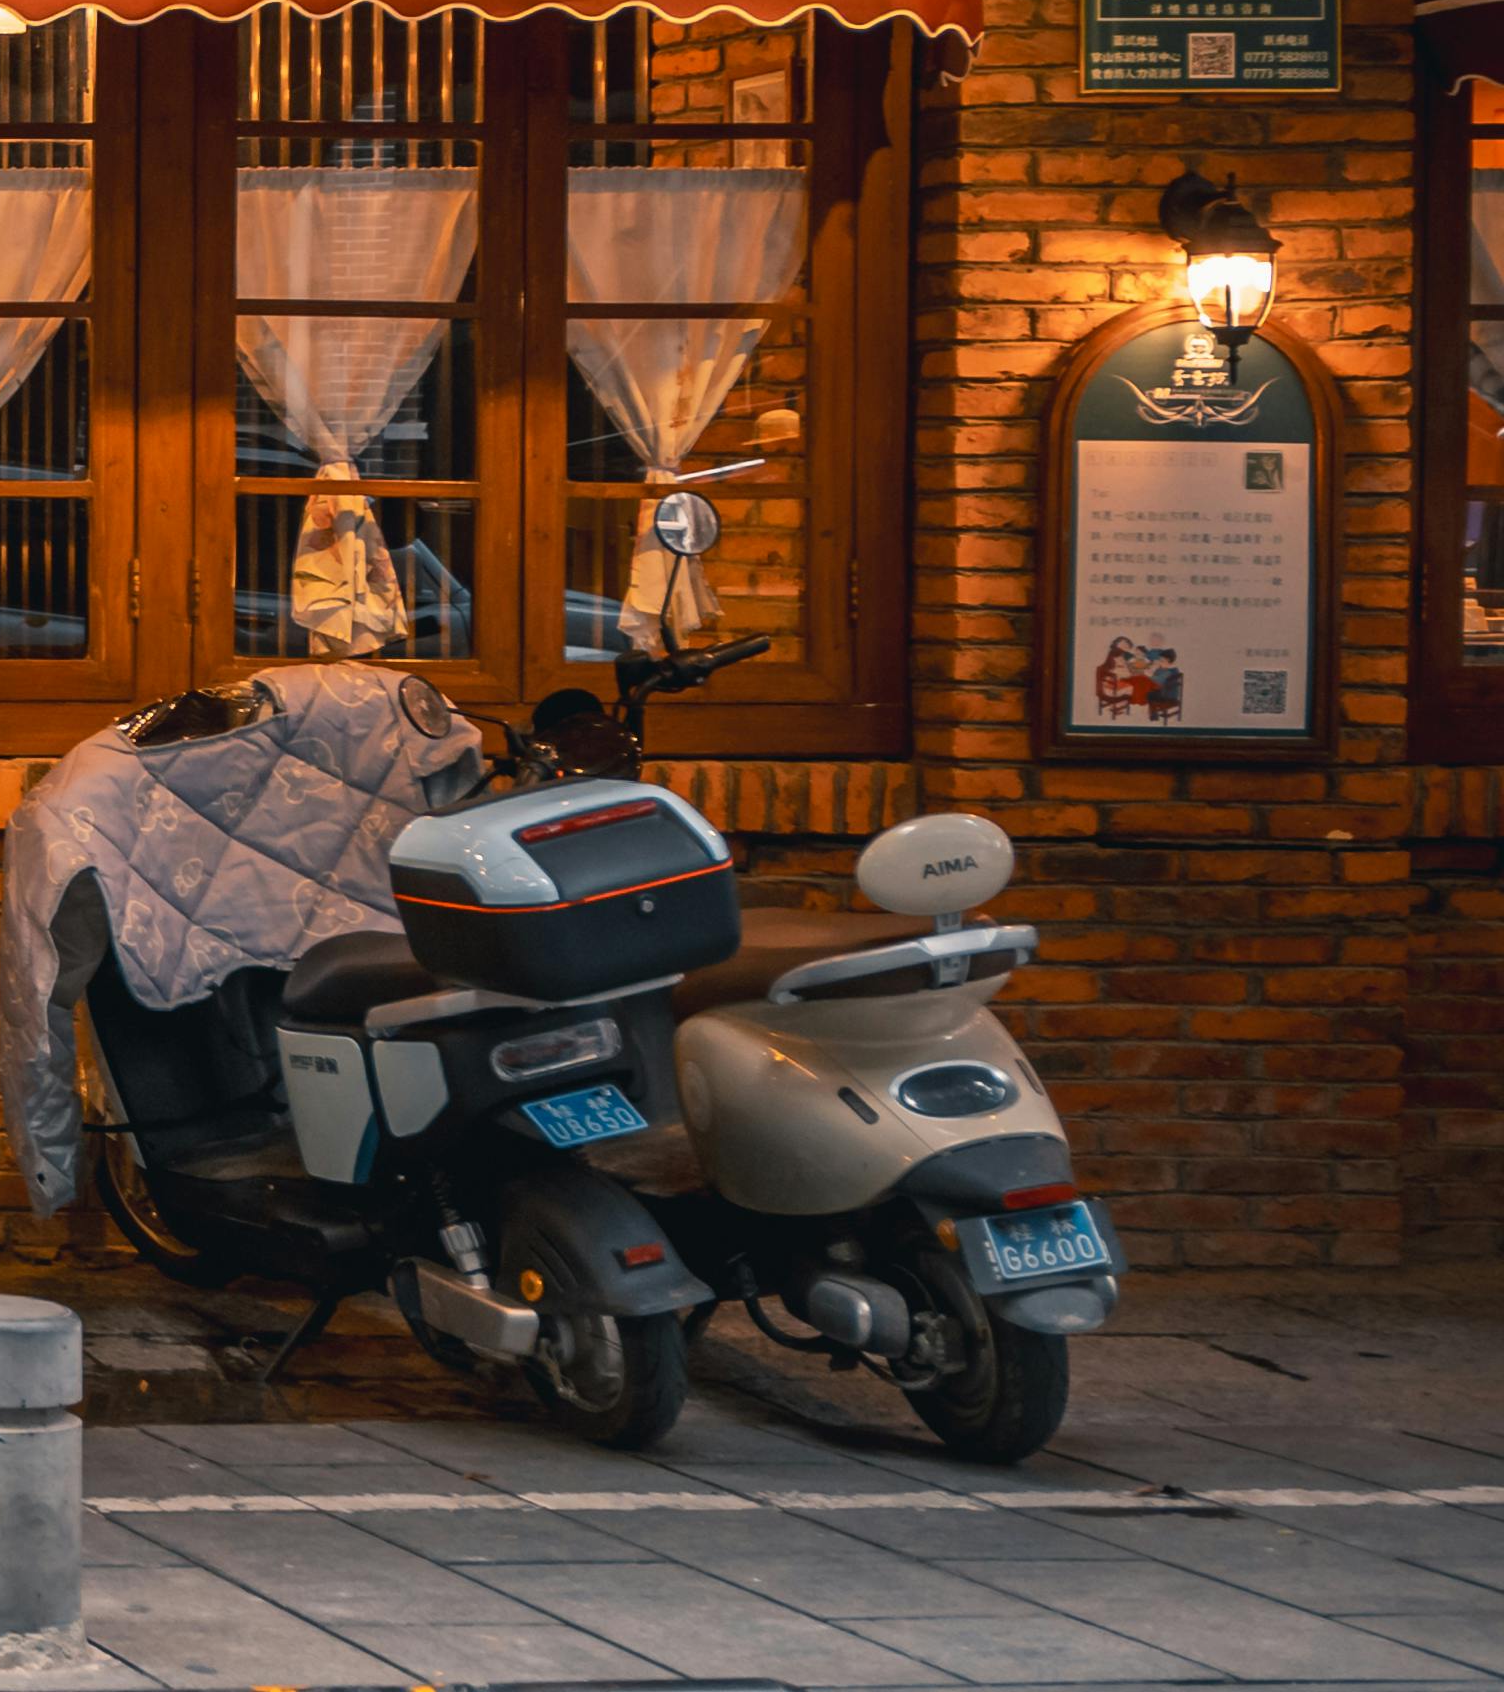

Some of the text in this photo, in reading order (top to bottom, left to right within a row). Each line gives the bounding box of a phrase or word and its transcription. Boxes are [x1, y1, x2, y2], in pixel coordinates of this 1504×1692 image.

[922, 855, 979, 879] AIMA
[548, 1105, 637, 1142] U8650
[1003, 1233, 1097, 1272] G6600
